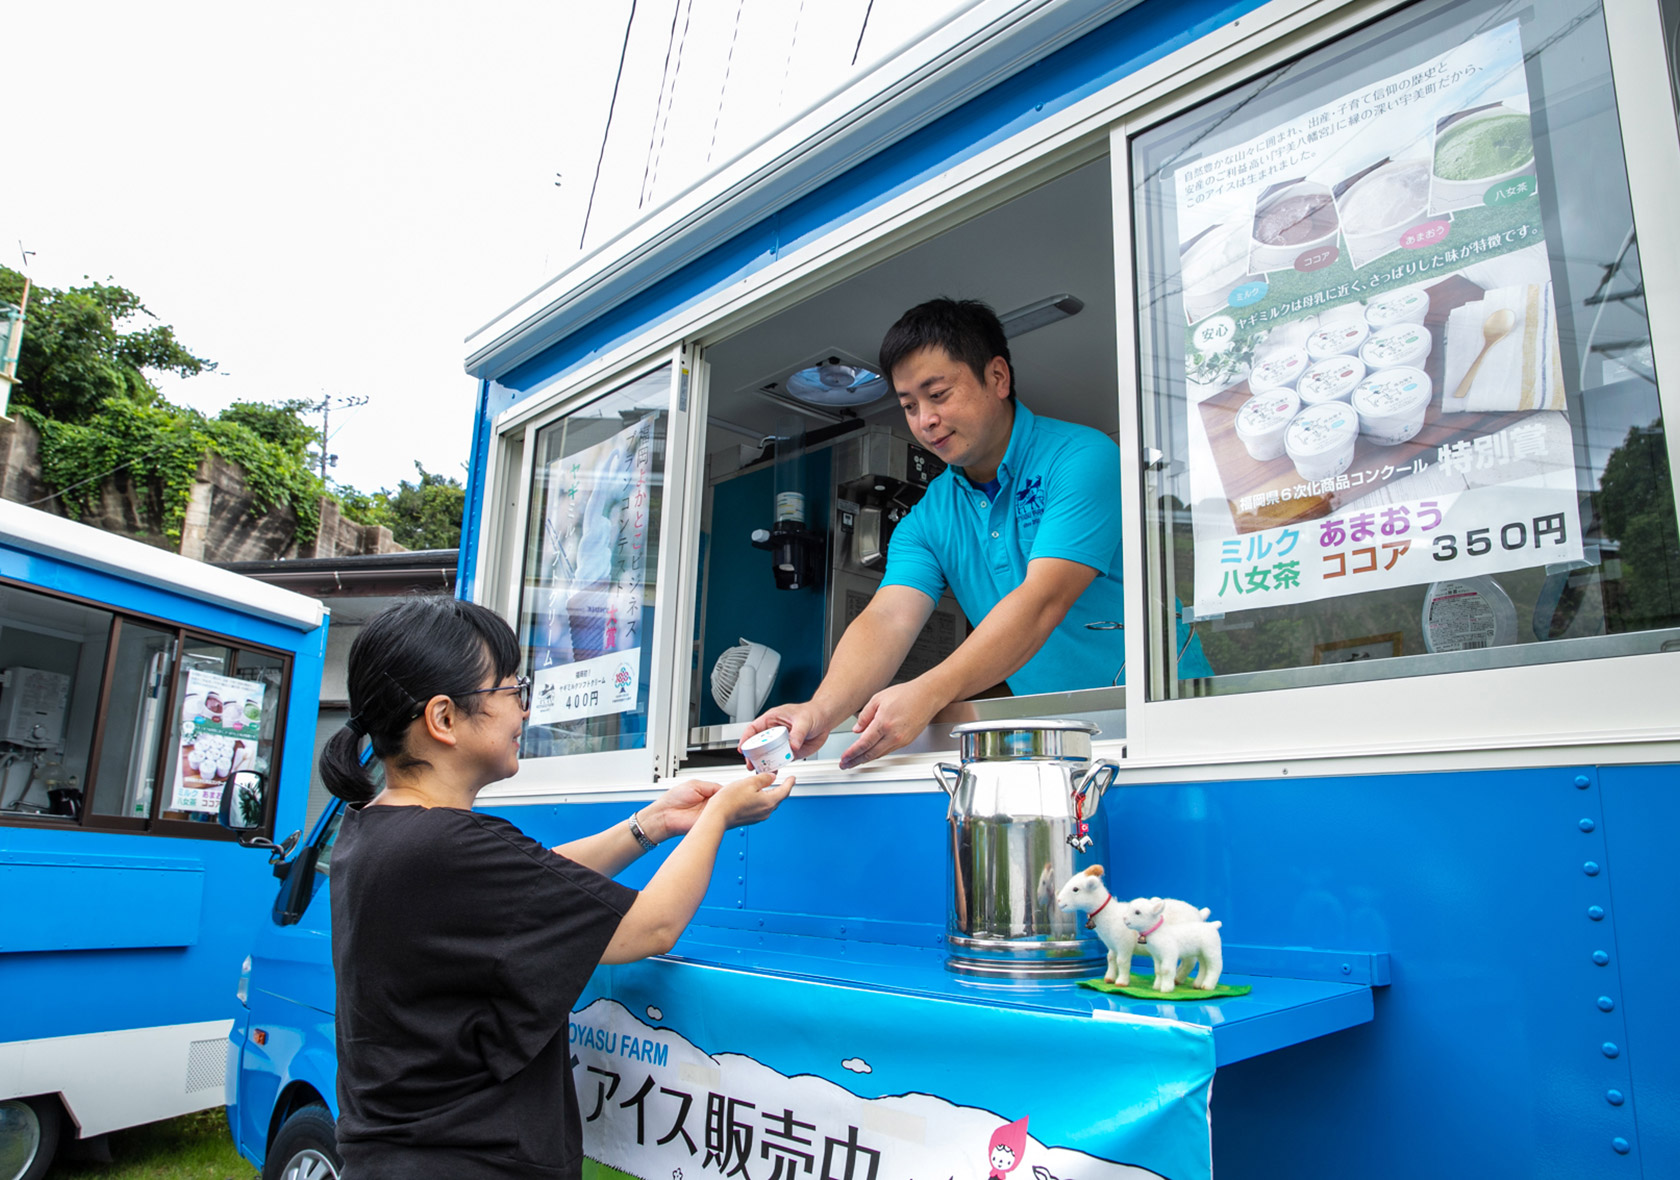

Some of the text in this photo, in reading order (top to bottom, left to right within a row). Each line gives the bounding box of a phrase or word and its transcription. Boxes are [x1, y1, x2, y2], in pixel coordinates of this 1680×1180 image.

[1186, 150, 1317, 208] このアイスは生まれました。
[1495, 182, 1528, 202] 八女茶
[1405, 225, 1445, 246] あまおう
[1304, 251, 1330, 267] ココア
[1237, 224, 1538, 329] ヤギミルクは母乳に近く、さっぱりした味が特徴です。
[1236, 287, 1260, 301] ミルク
[1202, 323, 1229, 341] 安心
[1438, 423, 1550, 477] 特別賞
[1220, 501, 1444, 564] ミルク あまおう
[1218, 512, 1568, 597] 八女茶 ココア 350円
[605, 604, 619, 650] 大賞
[565, 690, 599, 709] 400円
[620, 1034, 669, 1068] FARM
